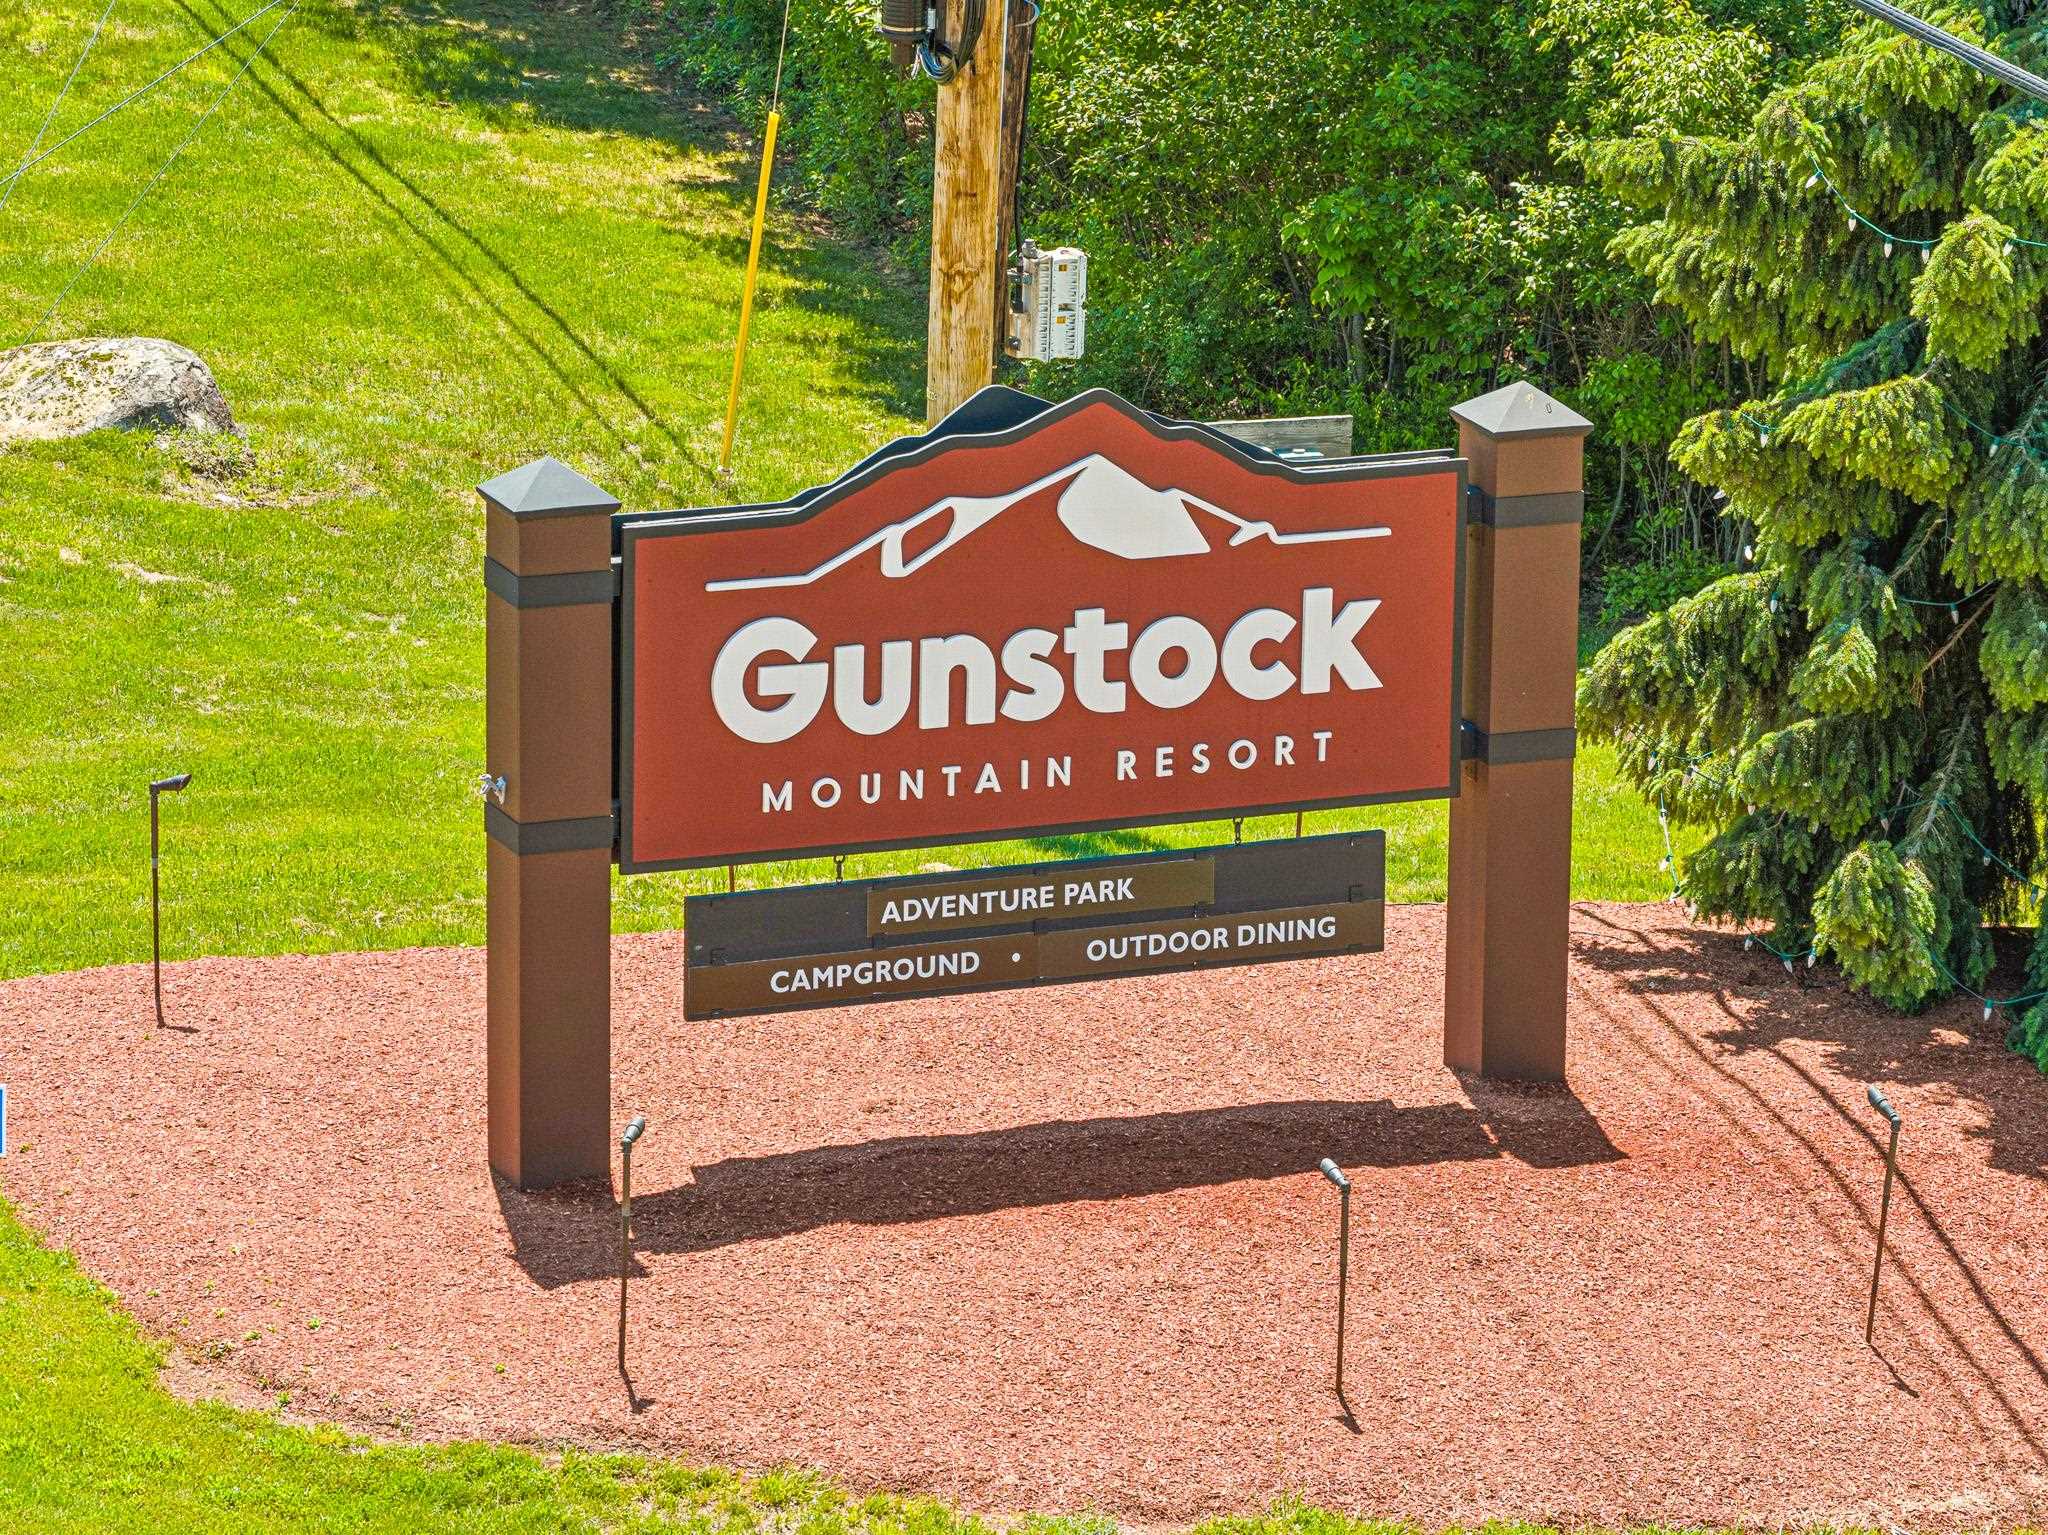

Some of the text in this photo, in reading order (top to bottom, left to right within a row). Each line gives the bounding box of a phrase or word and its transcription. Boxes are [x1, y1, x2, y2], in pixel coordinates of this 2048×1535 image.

[711, 587, 1384, 744] Gunstock
[762, 731, 1333, 813] MOUNTAIN RESORT
[880, 877, 1135, 925] ADVENTURE PARK
[770, 916, 1337, 995] CAMPGROUND OUTDOOR DINING
